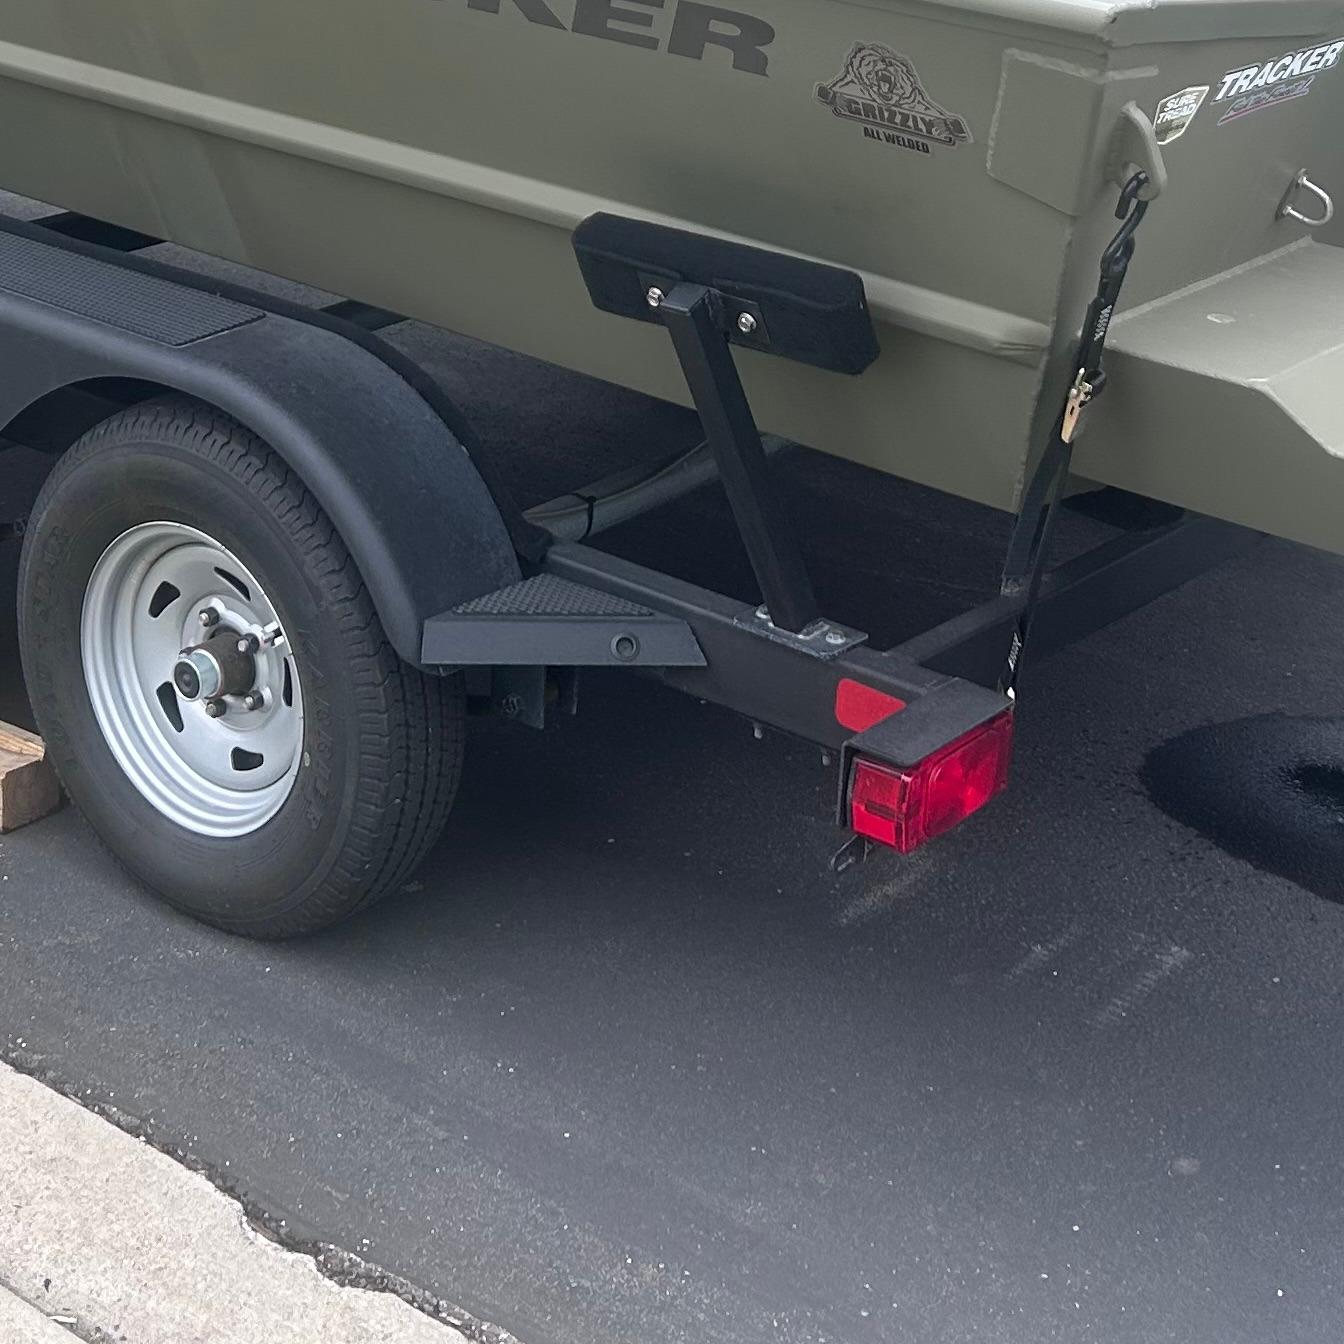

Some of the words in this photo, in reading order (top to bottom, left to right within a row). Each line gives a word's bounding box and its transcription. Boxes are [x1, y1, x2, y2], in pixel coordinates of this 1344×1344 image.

[1156, 103, 1198, 124] TREAD
[1164, 92, 1200, 111] SURE
[845, 97, 936, 137] GRIZZLY
[863, 126, 883, 142] ALL
[882, 131, 932, 154] WELDED
